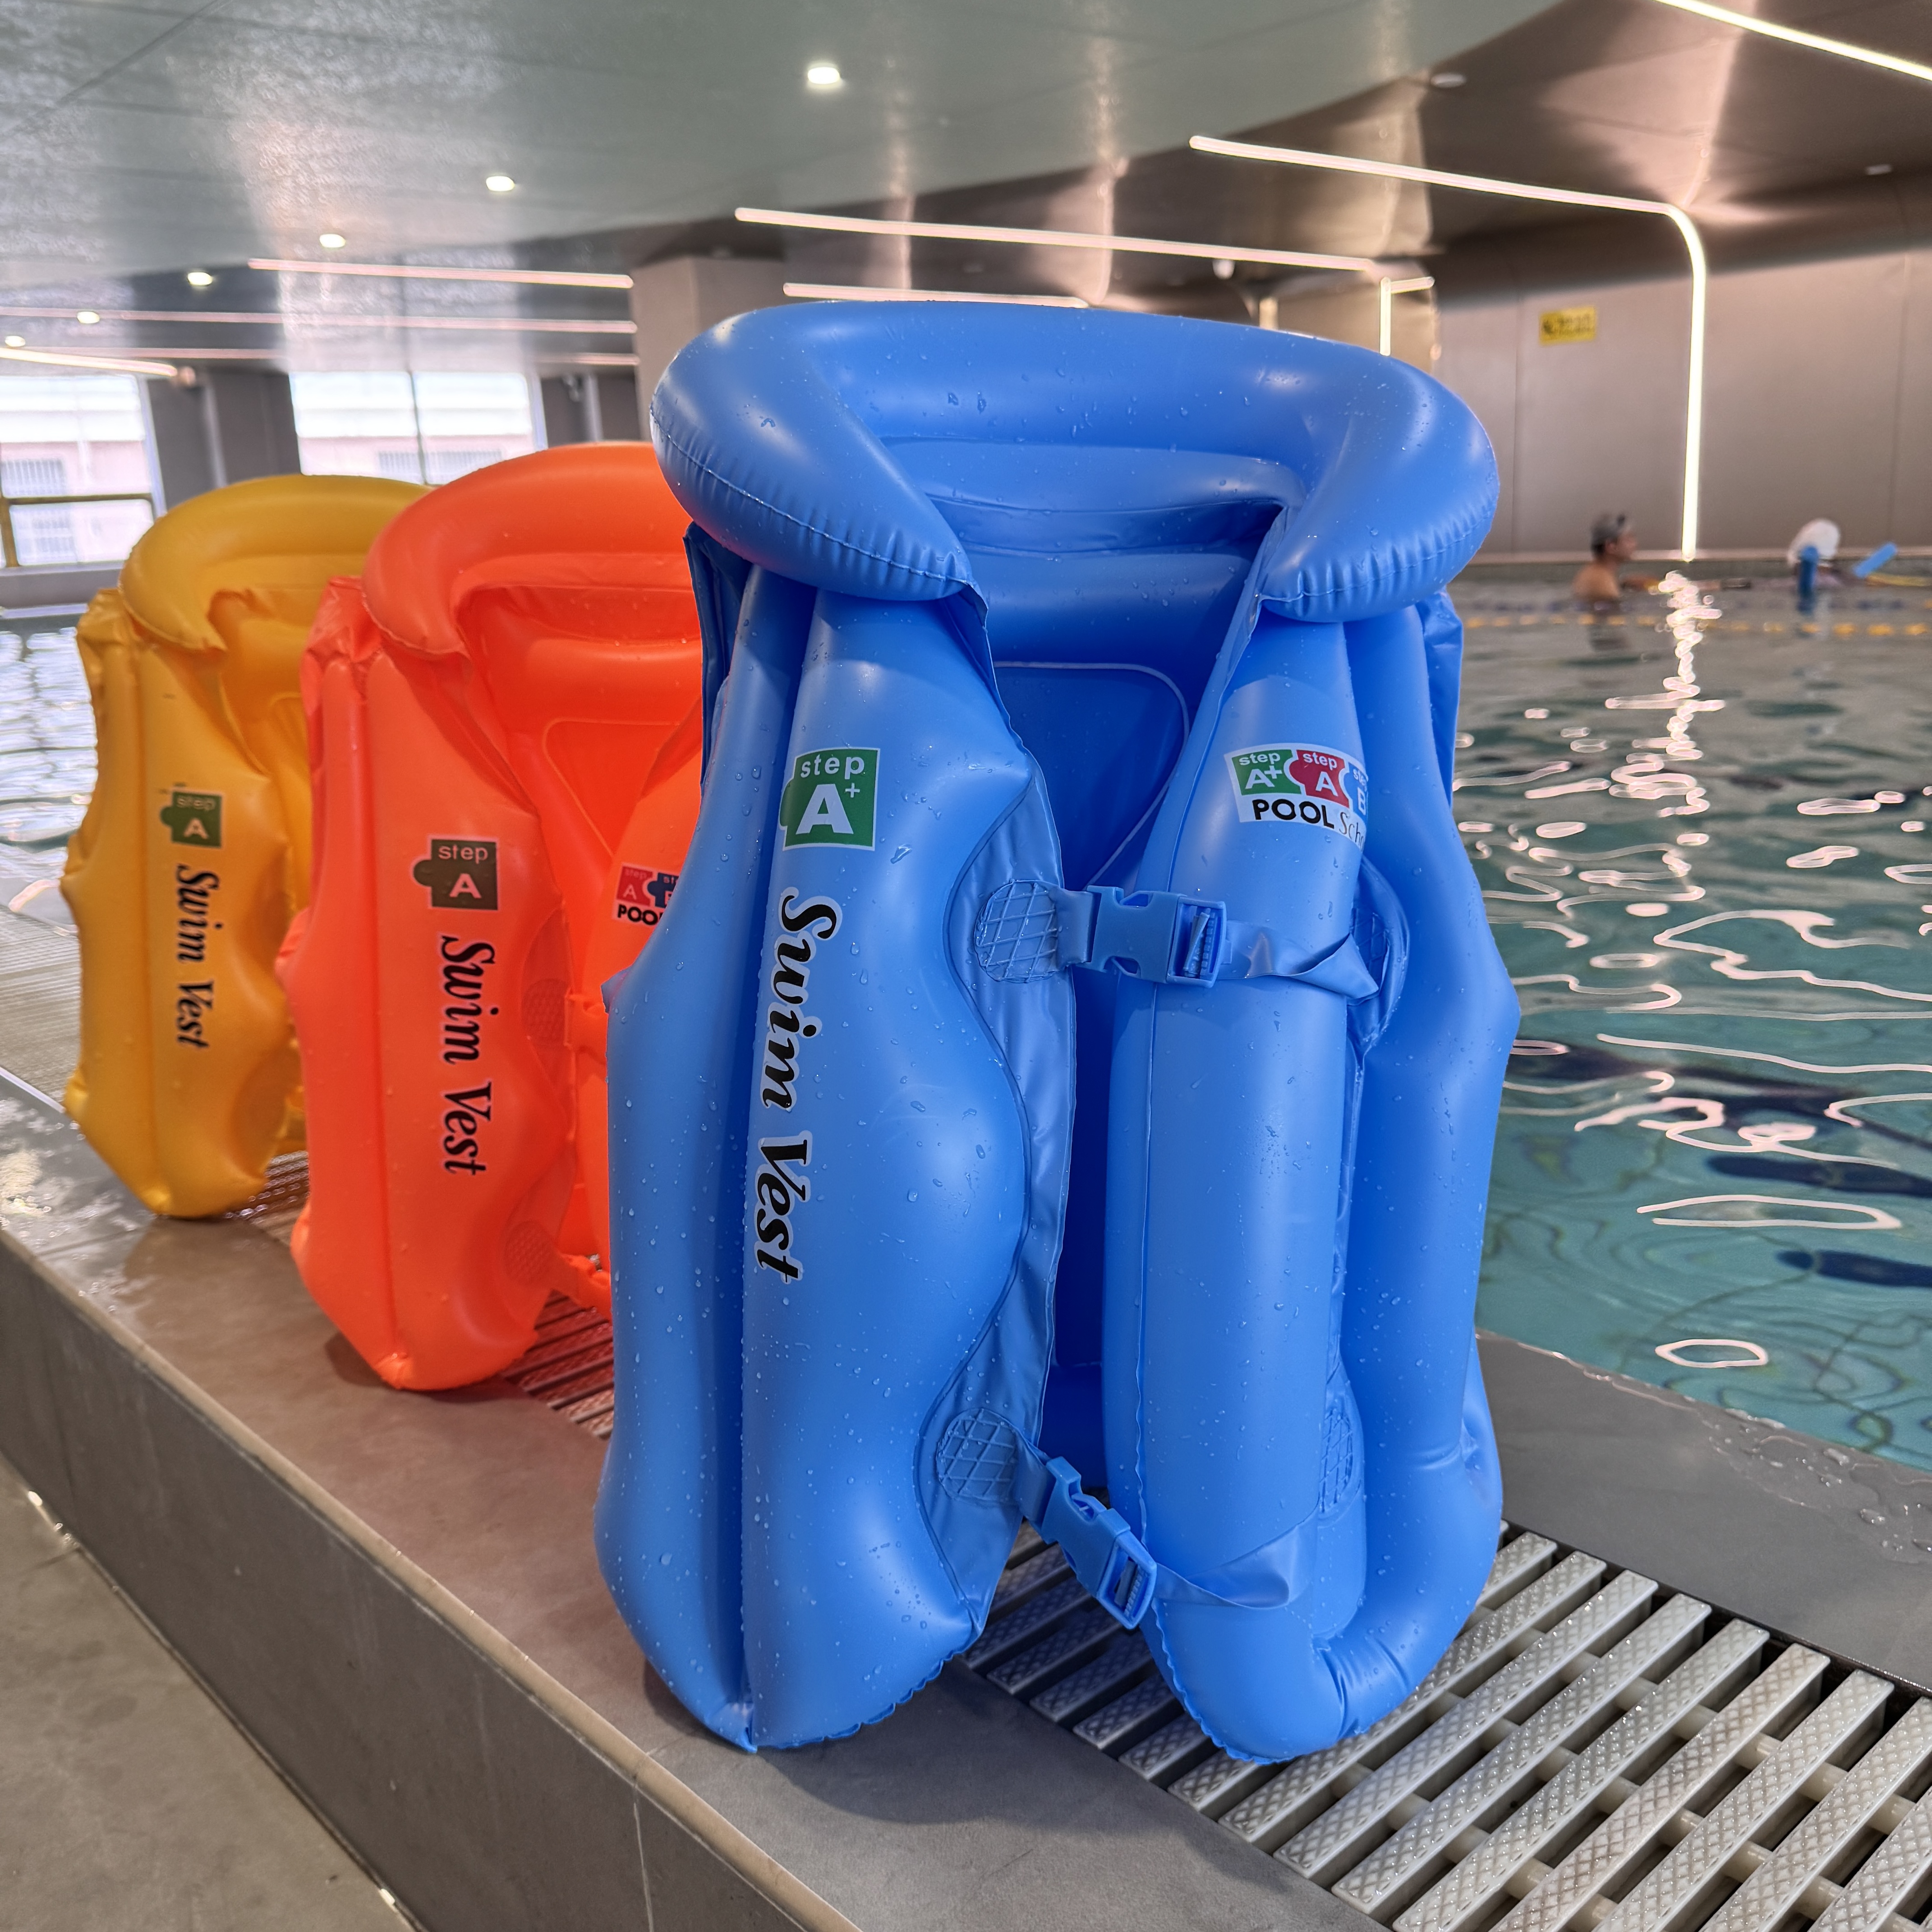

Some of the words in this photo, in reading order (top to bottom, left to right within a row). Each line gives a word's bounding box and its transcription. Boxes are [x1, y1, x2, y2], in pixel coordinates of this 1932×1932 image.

[800, 754, 865, 780] step
[1239, 752, 1280, 767] step
[1303, 752, 1337, 771] step
[1245, 765, 1283, 789] A+
[1316, 771, 1339, 796] A
[796, 782, 860, 835] A+
[1252, 799, 1335, 829] POOL
[183, 818, 209, 840] A
[438, 844, 488, 864] step
[449, 873, 482, 899] A
[623, 884, 637, 900] A
[176, 863, 223, 963] Swim
[176, 979, 215, 1049] Vest
[441, 934, 499, 1065] Swim
[763, 894, 837, 1109] Swim
[444, 1081, 492, 1175] Vest
[757, 1139, 808, 1283] Vest
